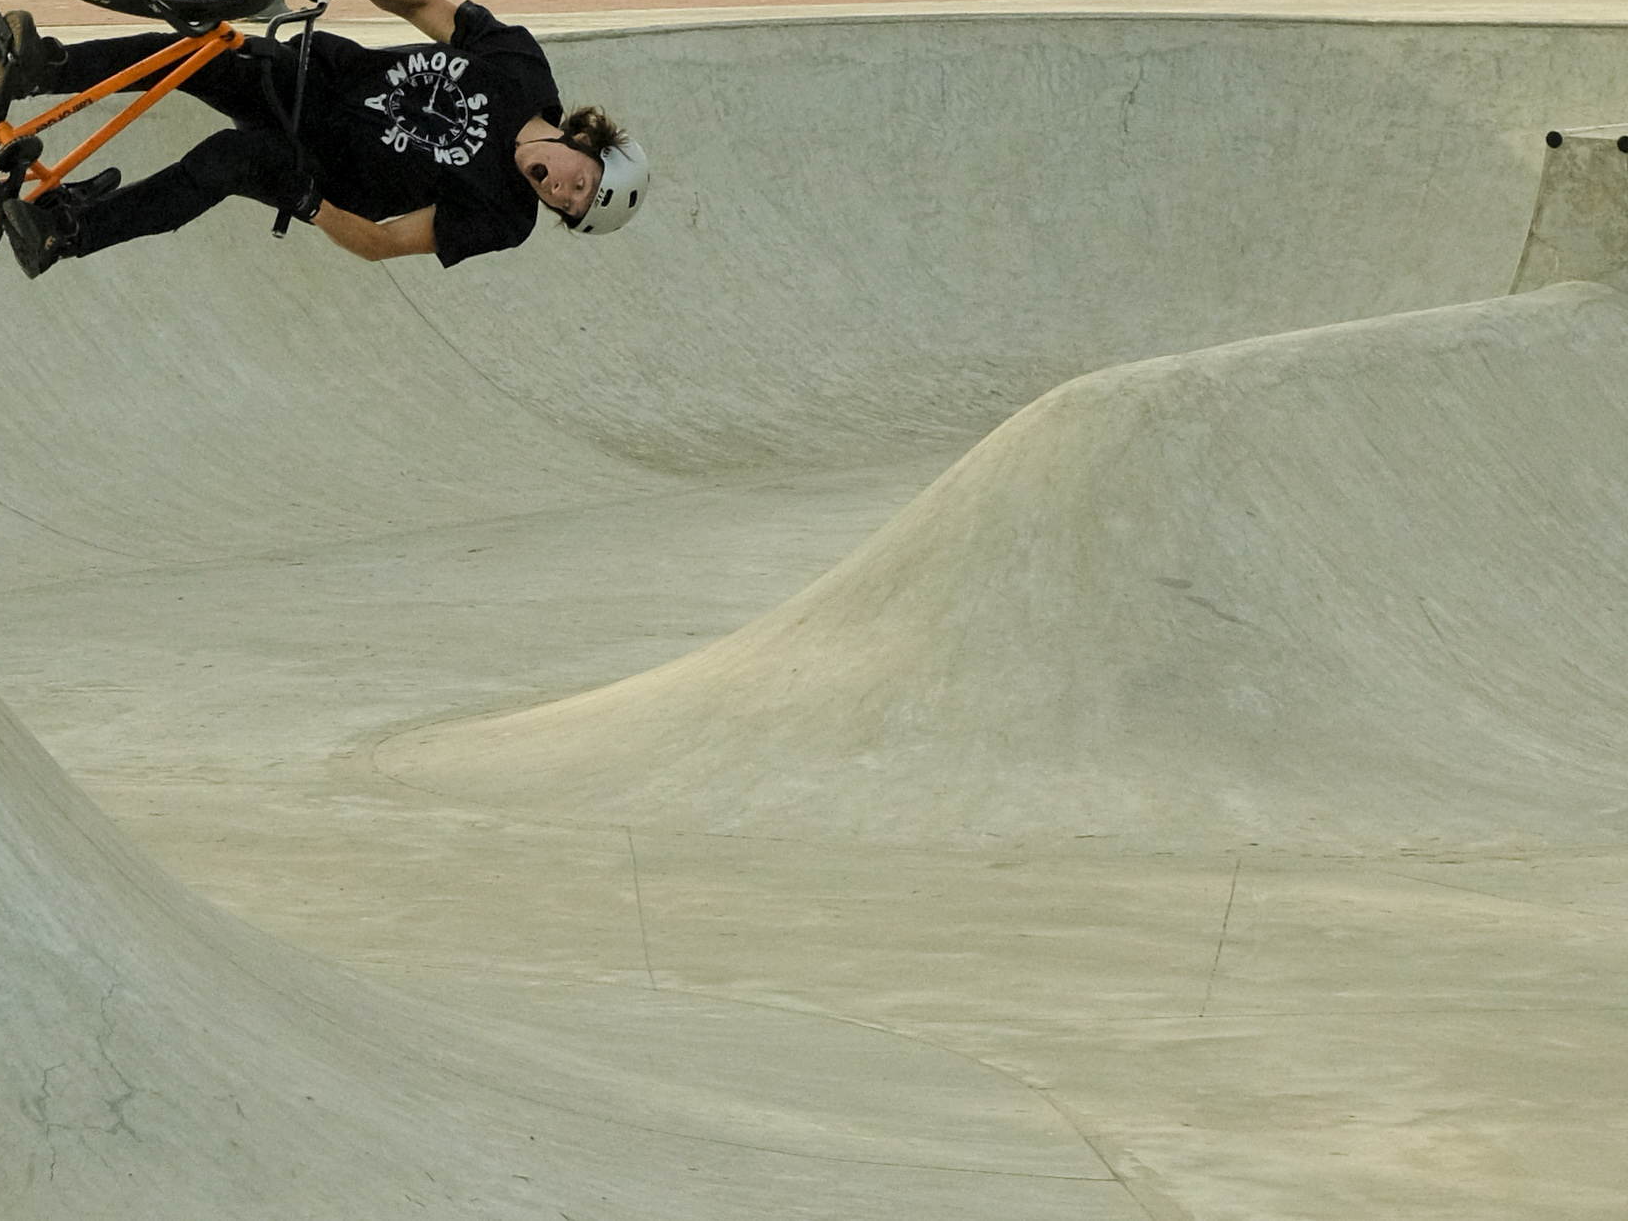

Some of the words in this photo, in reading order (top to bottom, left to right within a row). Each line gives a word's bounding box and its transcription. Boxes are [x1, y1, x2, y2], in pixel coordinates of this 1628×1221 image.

[386, 52, 470, 87] DOWN
[364, 93, 388, 115] A
[380, 126, 409, 153] OF
[434, 93, 490, 166] SYSTEM
